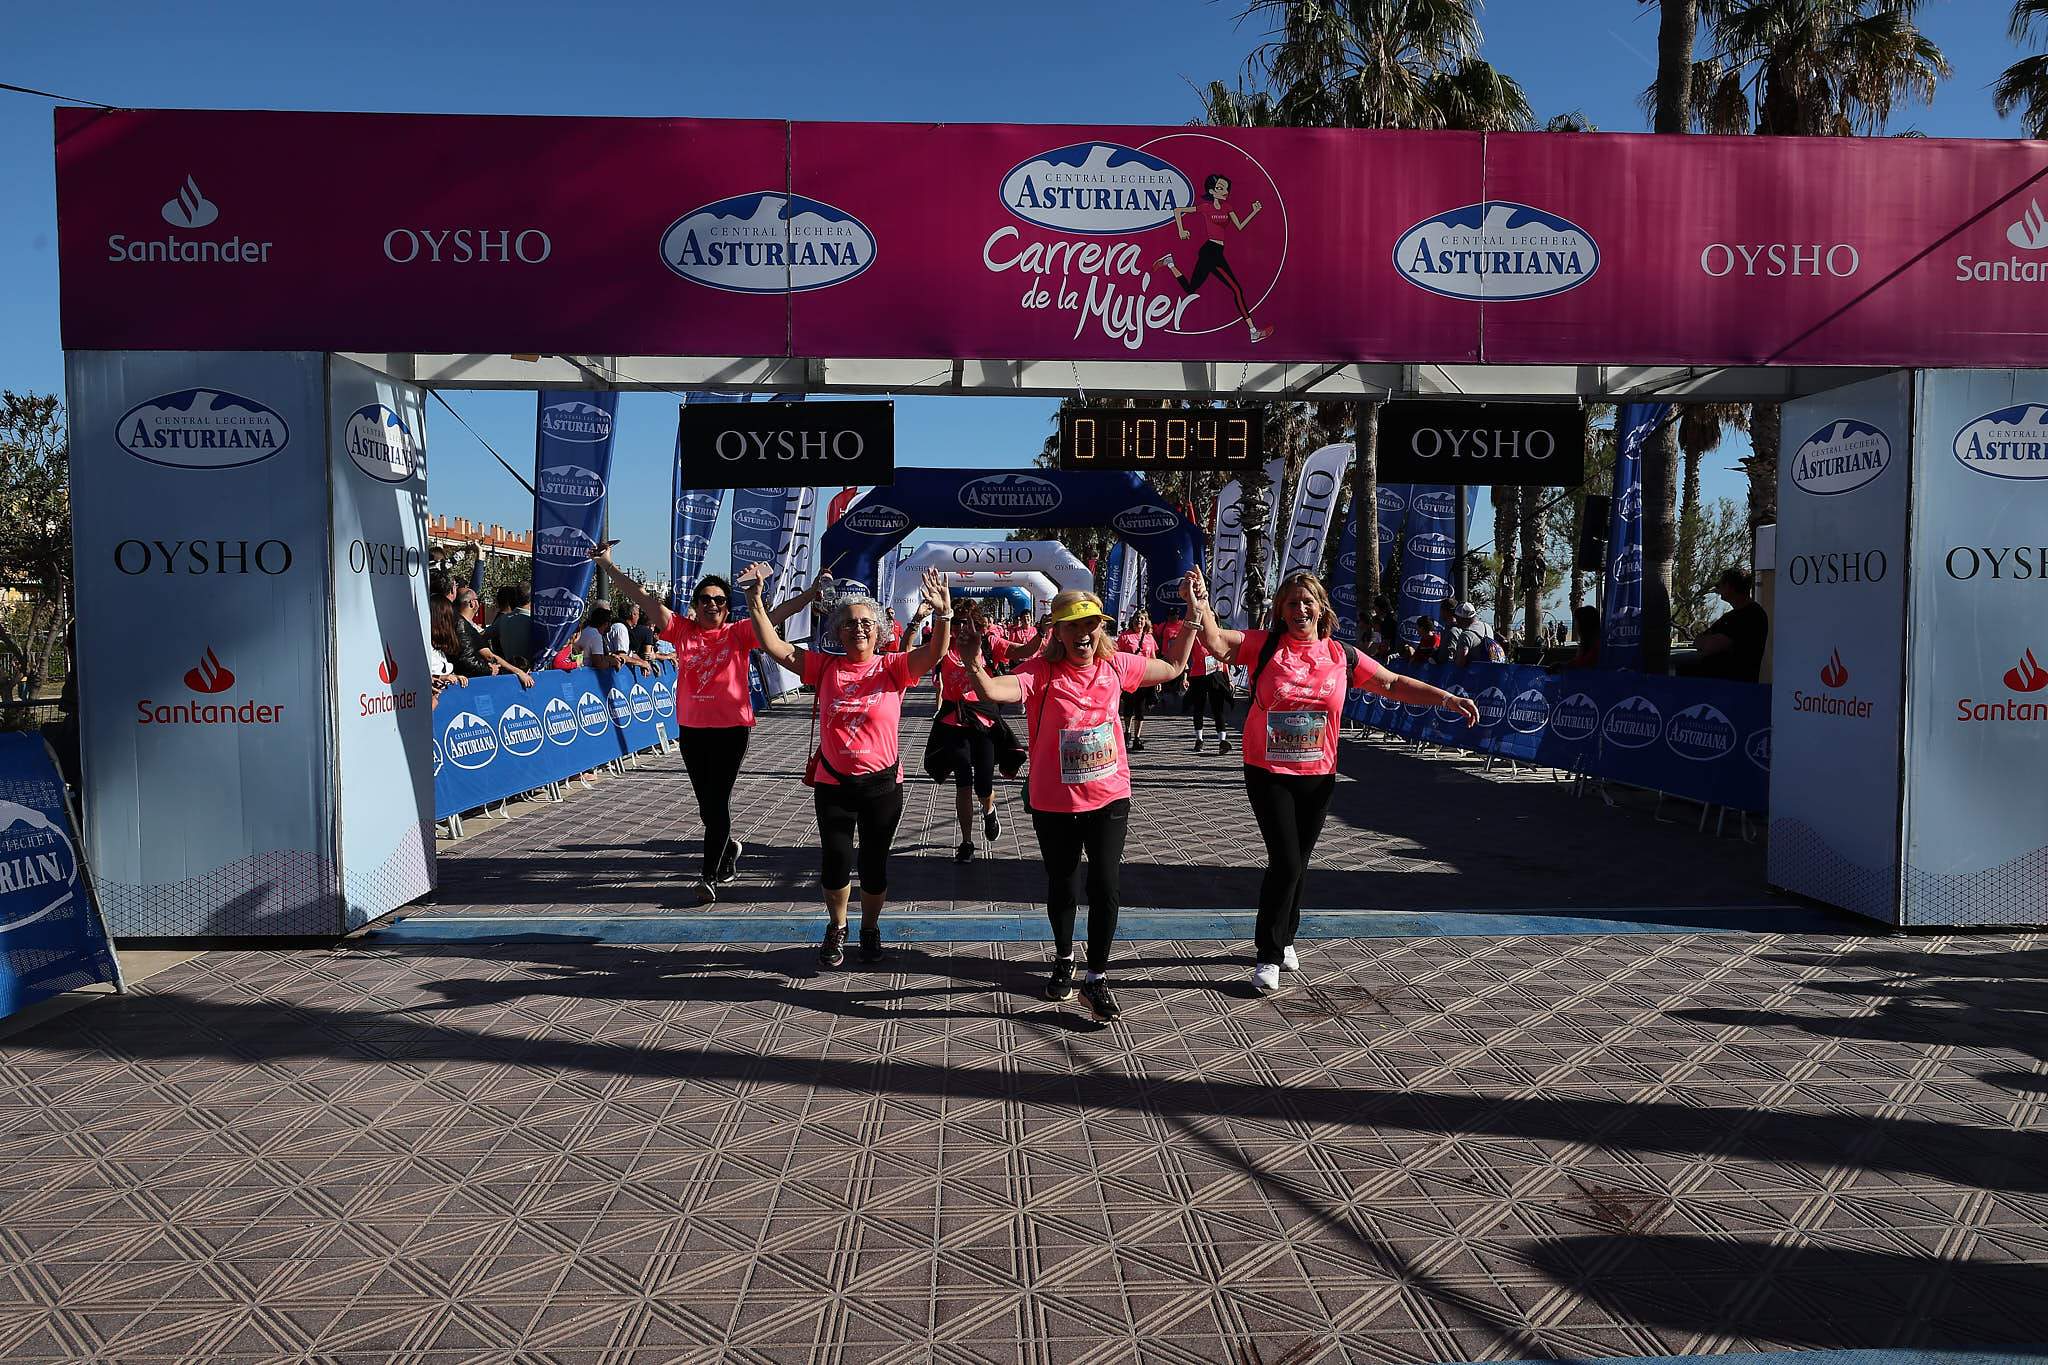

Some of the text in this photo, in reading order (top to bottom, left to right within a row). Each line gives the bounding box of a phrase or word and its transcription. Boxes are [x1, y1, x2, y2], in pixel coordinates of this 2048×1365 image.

[1045, 172, 1173, 184] CENTRAL LECHERA
[1015, 174, 1178, 211] ASTURIANA
[710, 226, 777, 237] CENTRAL
[1441, 235, 1577, 247] CENTRAL LECHERA
[108, 235, 273, 263] Santander
[383, 229, 552, 264] OYSHO
[677, 228, 861, 267] ASTURIANA
[983, 225, 1142, 276] Carrera
[1409, 237, 1584, 275] ASTURIANA
[1700, 243, 1860, 277] OYSHO
[1021, 275, 1079, 310] de la
[1073, 271, 1200, 350] Mujer
[129, 418, 278, 449] ASTURIANA
[155, 416, 271, 425] CENTRAL LECHERA
[543, 412, 609, 434] ASTURIANA
[1988, 430, 2038, 438] CENTRAL
[351, 425, 413, 469] ASTURIANA
[715, 430, 864, 461] OYSHO
[1411, 427, 1556, 460] OYSHO
[1797, 449, 1883, 481] ASTURIANA
[966, 487, 1055, 506] ASTURIANA
[737, 512, 778, 528] ASTURIANA
[848, 516, 904, 528] ASTURIANA
[1118, 517, 1175, 529] ASTURIANA
[1285, 470, 1335, 575] YSHO
[114, 539, 293, 576] OYSHO
[348, 539, 420, 578] OYSHO
[953, 547, 1032, 564] OYSHO
[1789, 550, 1887, 586] OYSHO
[1406, 581, 1450, 597] ASTURIANA
[137, 700, 285, 724] Santander
[360, 691, 417, 718] Santander
[1509, 703, 1546, 724] ASTURIANA
[1793, 691, 1873, 719] Santander
[1554, 708, 1594, 730] ASTURIANA
[1605, 713, 1656, 738] ASTURIANA
[449, 735, 496, 759] ASTURIANA
[503, 725, 542, 746] ASTURIANA
[1669, 721, 1727, 750] ASTURIANA
[5, 833, 56, 852] LECHER
